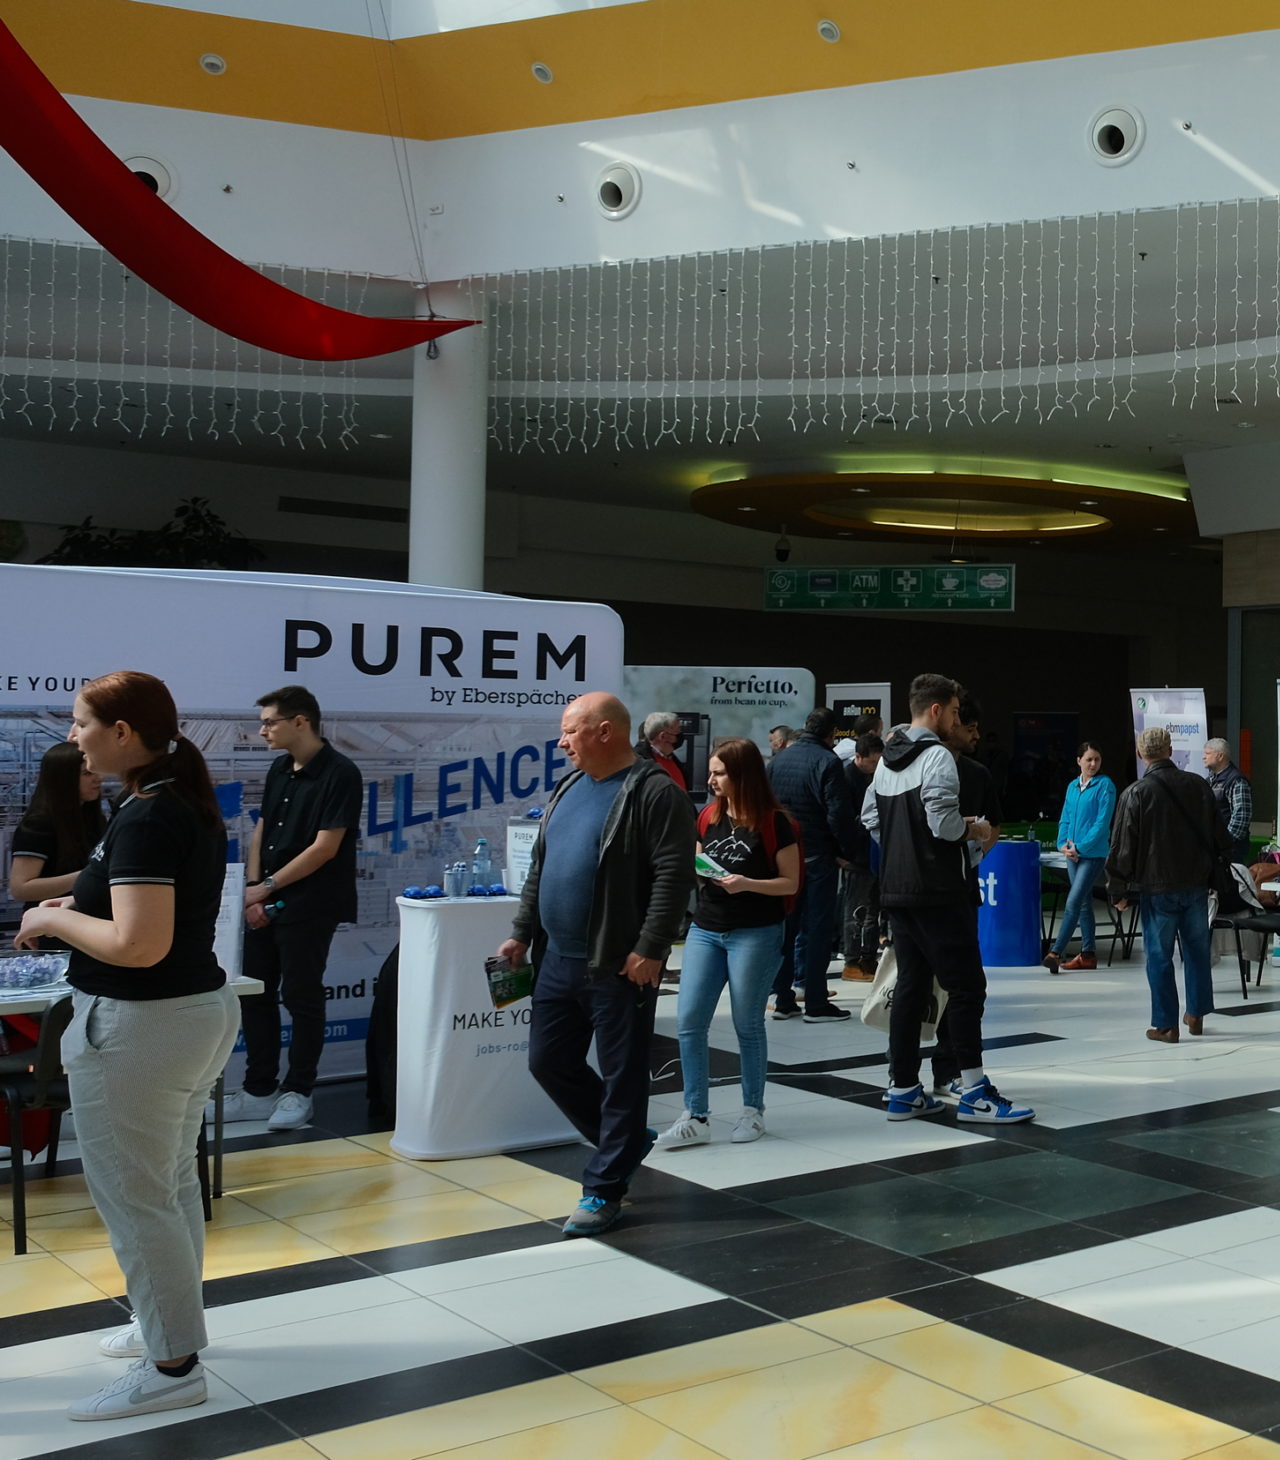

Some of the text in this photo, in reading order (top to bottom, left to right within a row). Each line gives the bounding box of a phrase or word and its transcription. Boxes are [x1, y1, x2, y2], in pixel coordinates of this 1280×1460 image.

[852, 575, 878, 588] ATM
[284, 619, 587, 682] PUREM
[712, 675, 798, 696] Perfetto,
[430, 687, 456, 706] by
[710, 696, 788, 708] from bean to cup.
[1165, 722, 1200, 736] ebmpapst
[452, 1008, 532, 1031] MAKE YO
[475, 1041, 530, 1058] jobs-ro@
